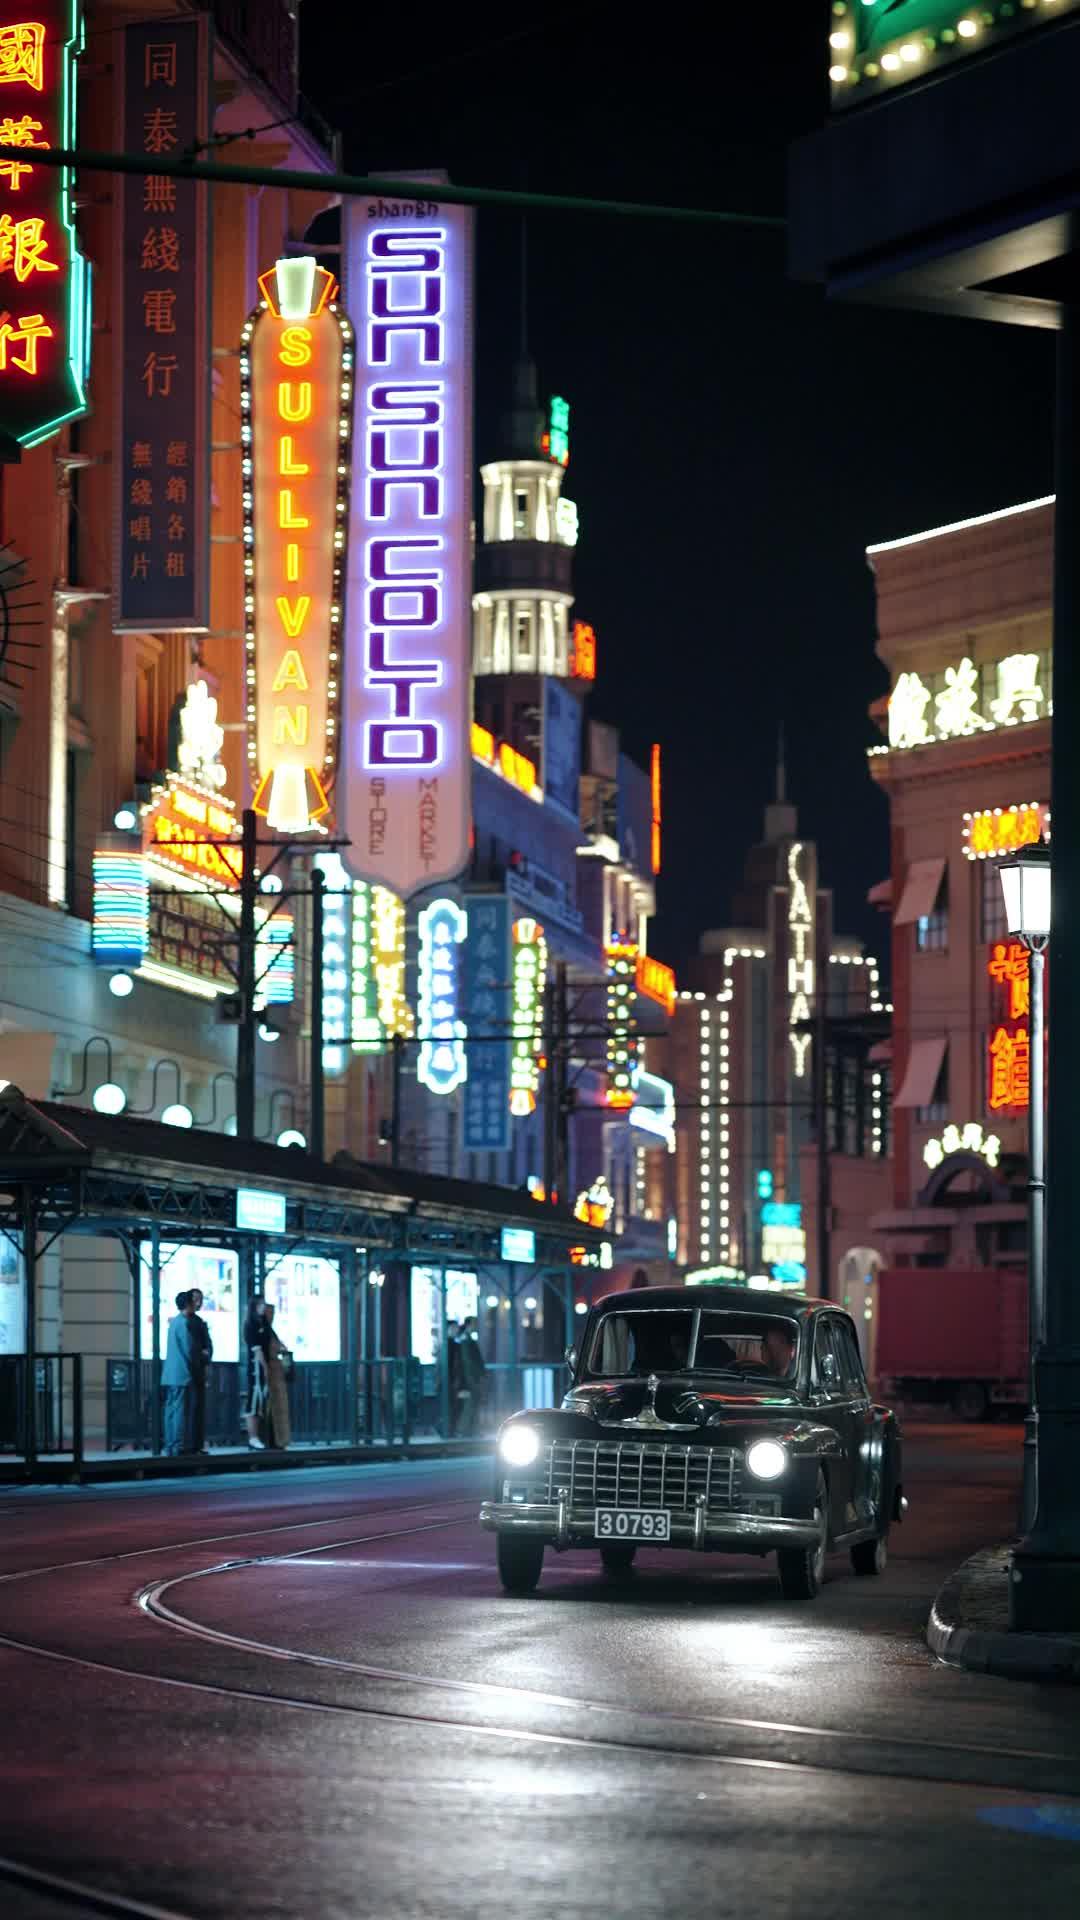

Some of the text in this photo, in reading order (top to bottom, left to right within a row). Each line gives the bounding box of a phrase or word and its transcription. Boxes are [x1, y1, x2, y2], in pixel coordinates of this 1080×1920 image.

[364, 226, 446, 367] SUN
[364, 379, 446, 522] SUN
[272, 325, 314, 747] SULLIVAN
[368, 777, 387, 856] STORE
[600, 1513, 667, 1537] 30793
